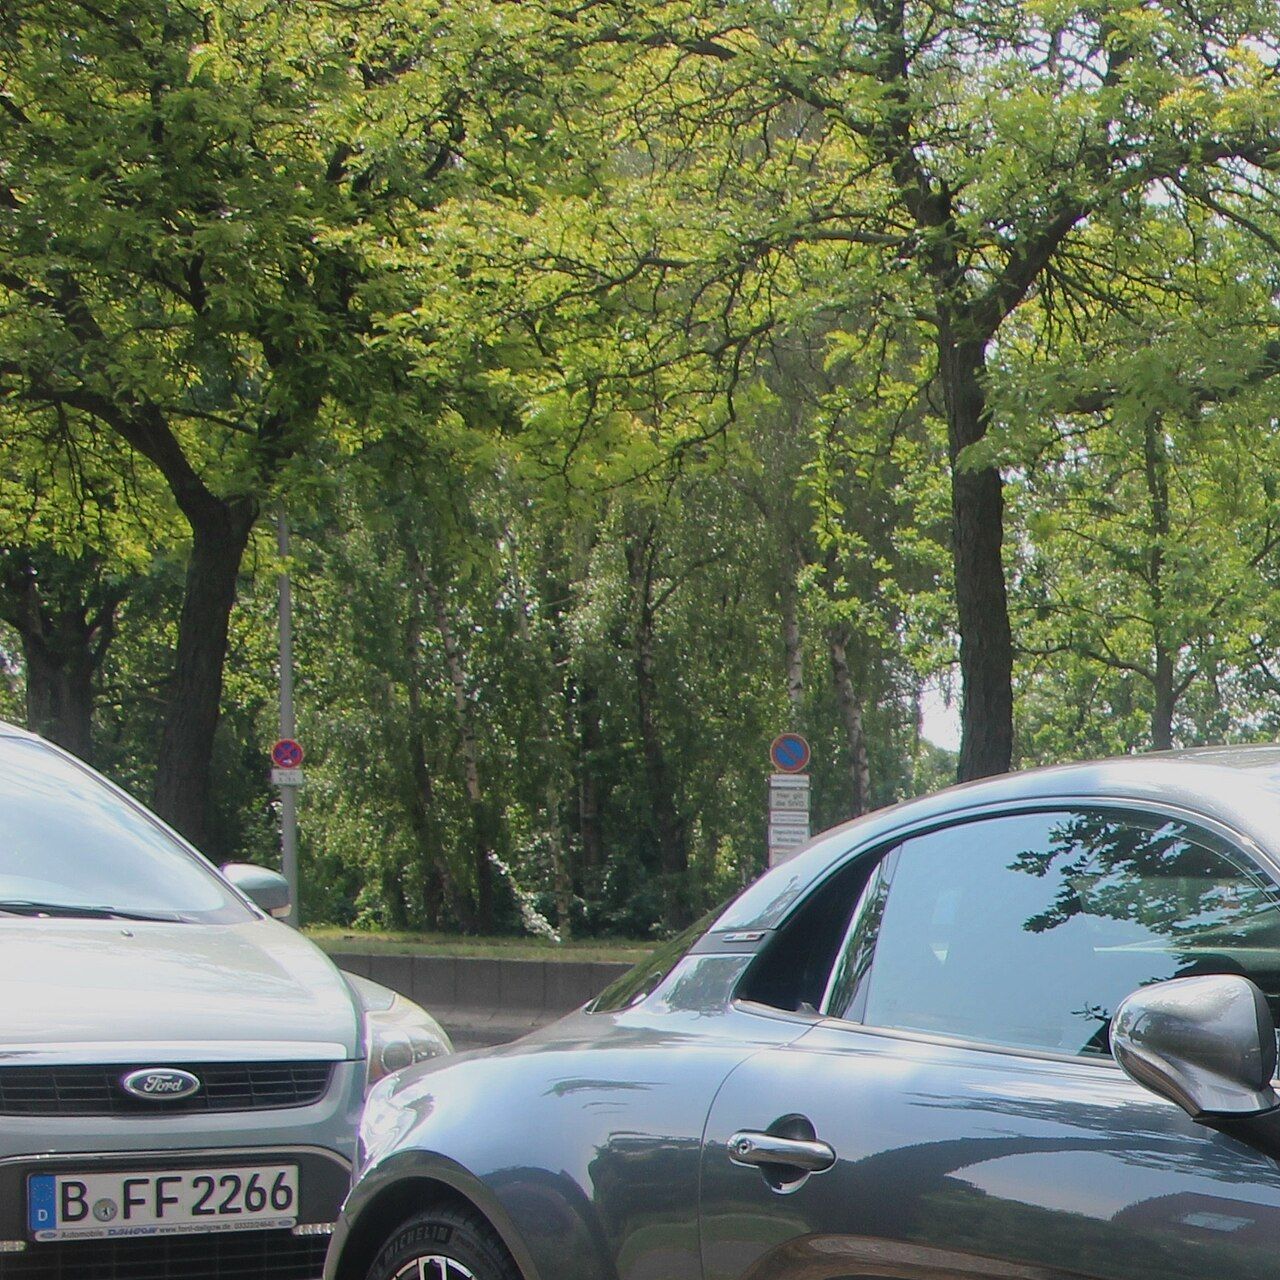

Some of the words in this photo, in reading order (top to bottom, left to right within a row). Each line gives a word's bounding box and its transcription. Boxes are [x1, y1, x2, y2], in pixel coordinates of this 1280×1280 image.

[143, 1074, 183, 1092] Ford
[61, 1180, 89, 1222] B
[123, 1176, 183, 1219] FF
[191, 1171, 294, 1216] 2266
[38, 1208, 48, 1222] D
[61, 1230, 104, 1239] Automobile
